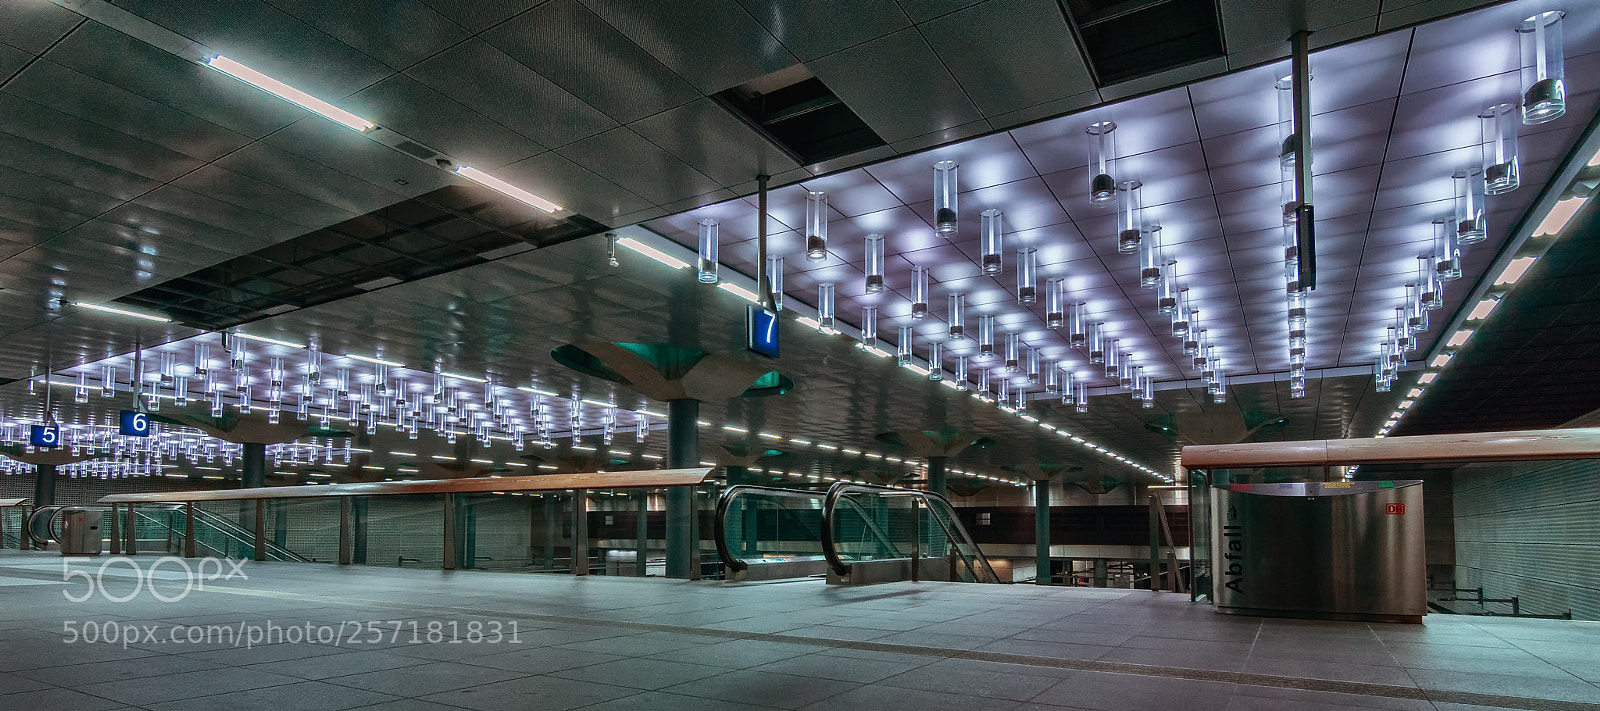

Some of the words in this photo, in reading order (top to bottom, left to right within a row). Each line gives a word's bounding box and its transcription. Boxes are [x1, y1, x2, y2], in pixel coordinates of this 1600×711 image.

[764, 309, 775, 343] 7
[133, 413, 147, 431] 6
[42, 427, 56, 443] 5
[1387, 503, 1404, 515] DB
[1224, 525, 1243, 594] Abfall
